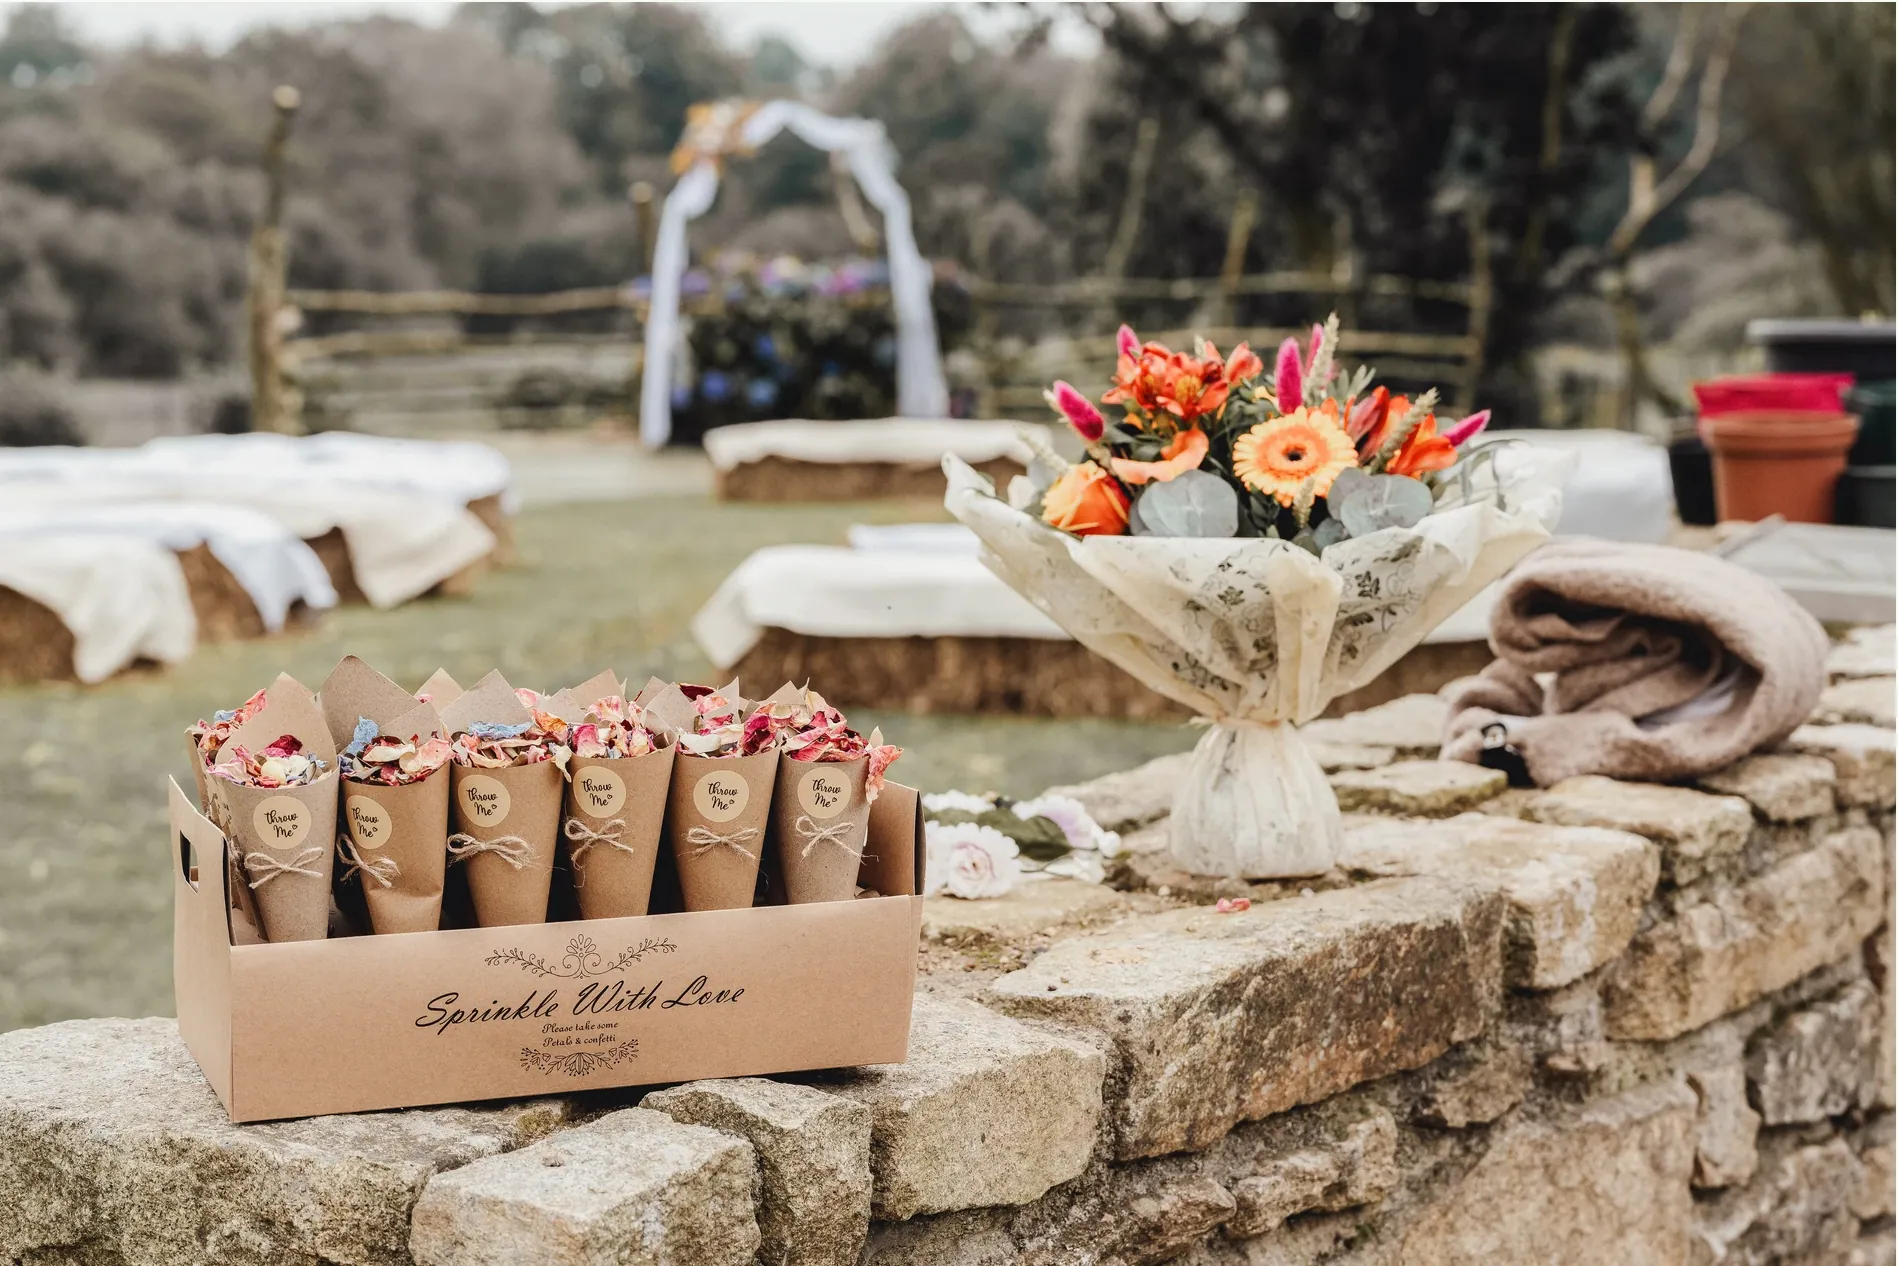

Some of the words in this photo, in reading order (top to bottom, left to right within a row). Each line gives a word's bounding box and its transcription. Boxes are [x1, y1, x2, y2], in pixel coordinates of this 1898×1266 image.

[590, 793, 608, 806] Me
[712, 796, 729, 810] Me
[815, 793, 831, 807] Me
[474, 802, 493, 816] Me
[273, 825, 294, 838] Me
[357, 822, 373, 837] Me
[415, 989, 559, 1035] Sprinkle
[572, 980, 663, 1016] With
[661, 975, 745, 1009] Love
[542, 1023, 573, 1034] Please
[575, 1021, 595, 1031] take
[597, 1022, 618, 1030] some
[543, 1035, 573, 1047] Petals
[575, 1037, 581, 1045] &
[584, 1033, 616, 1046] confetti
